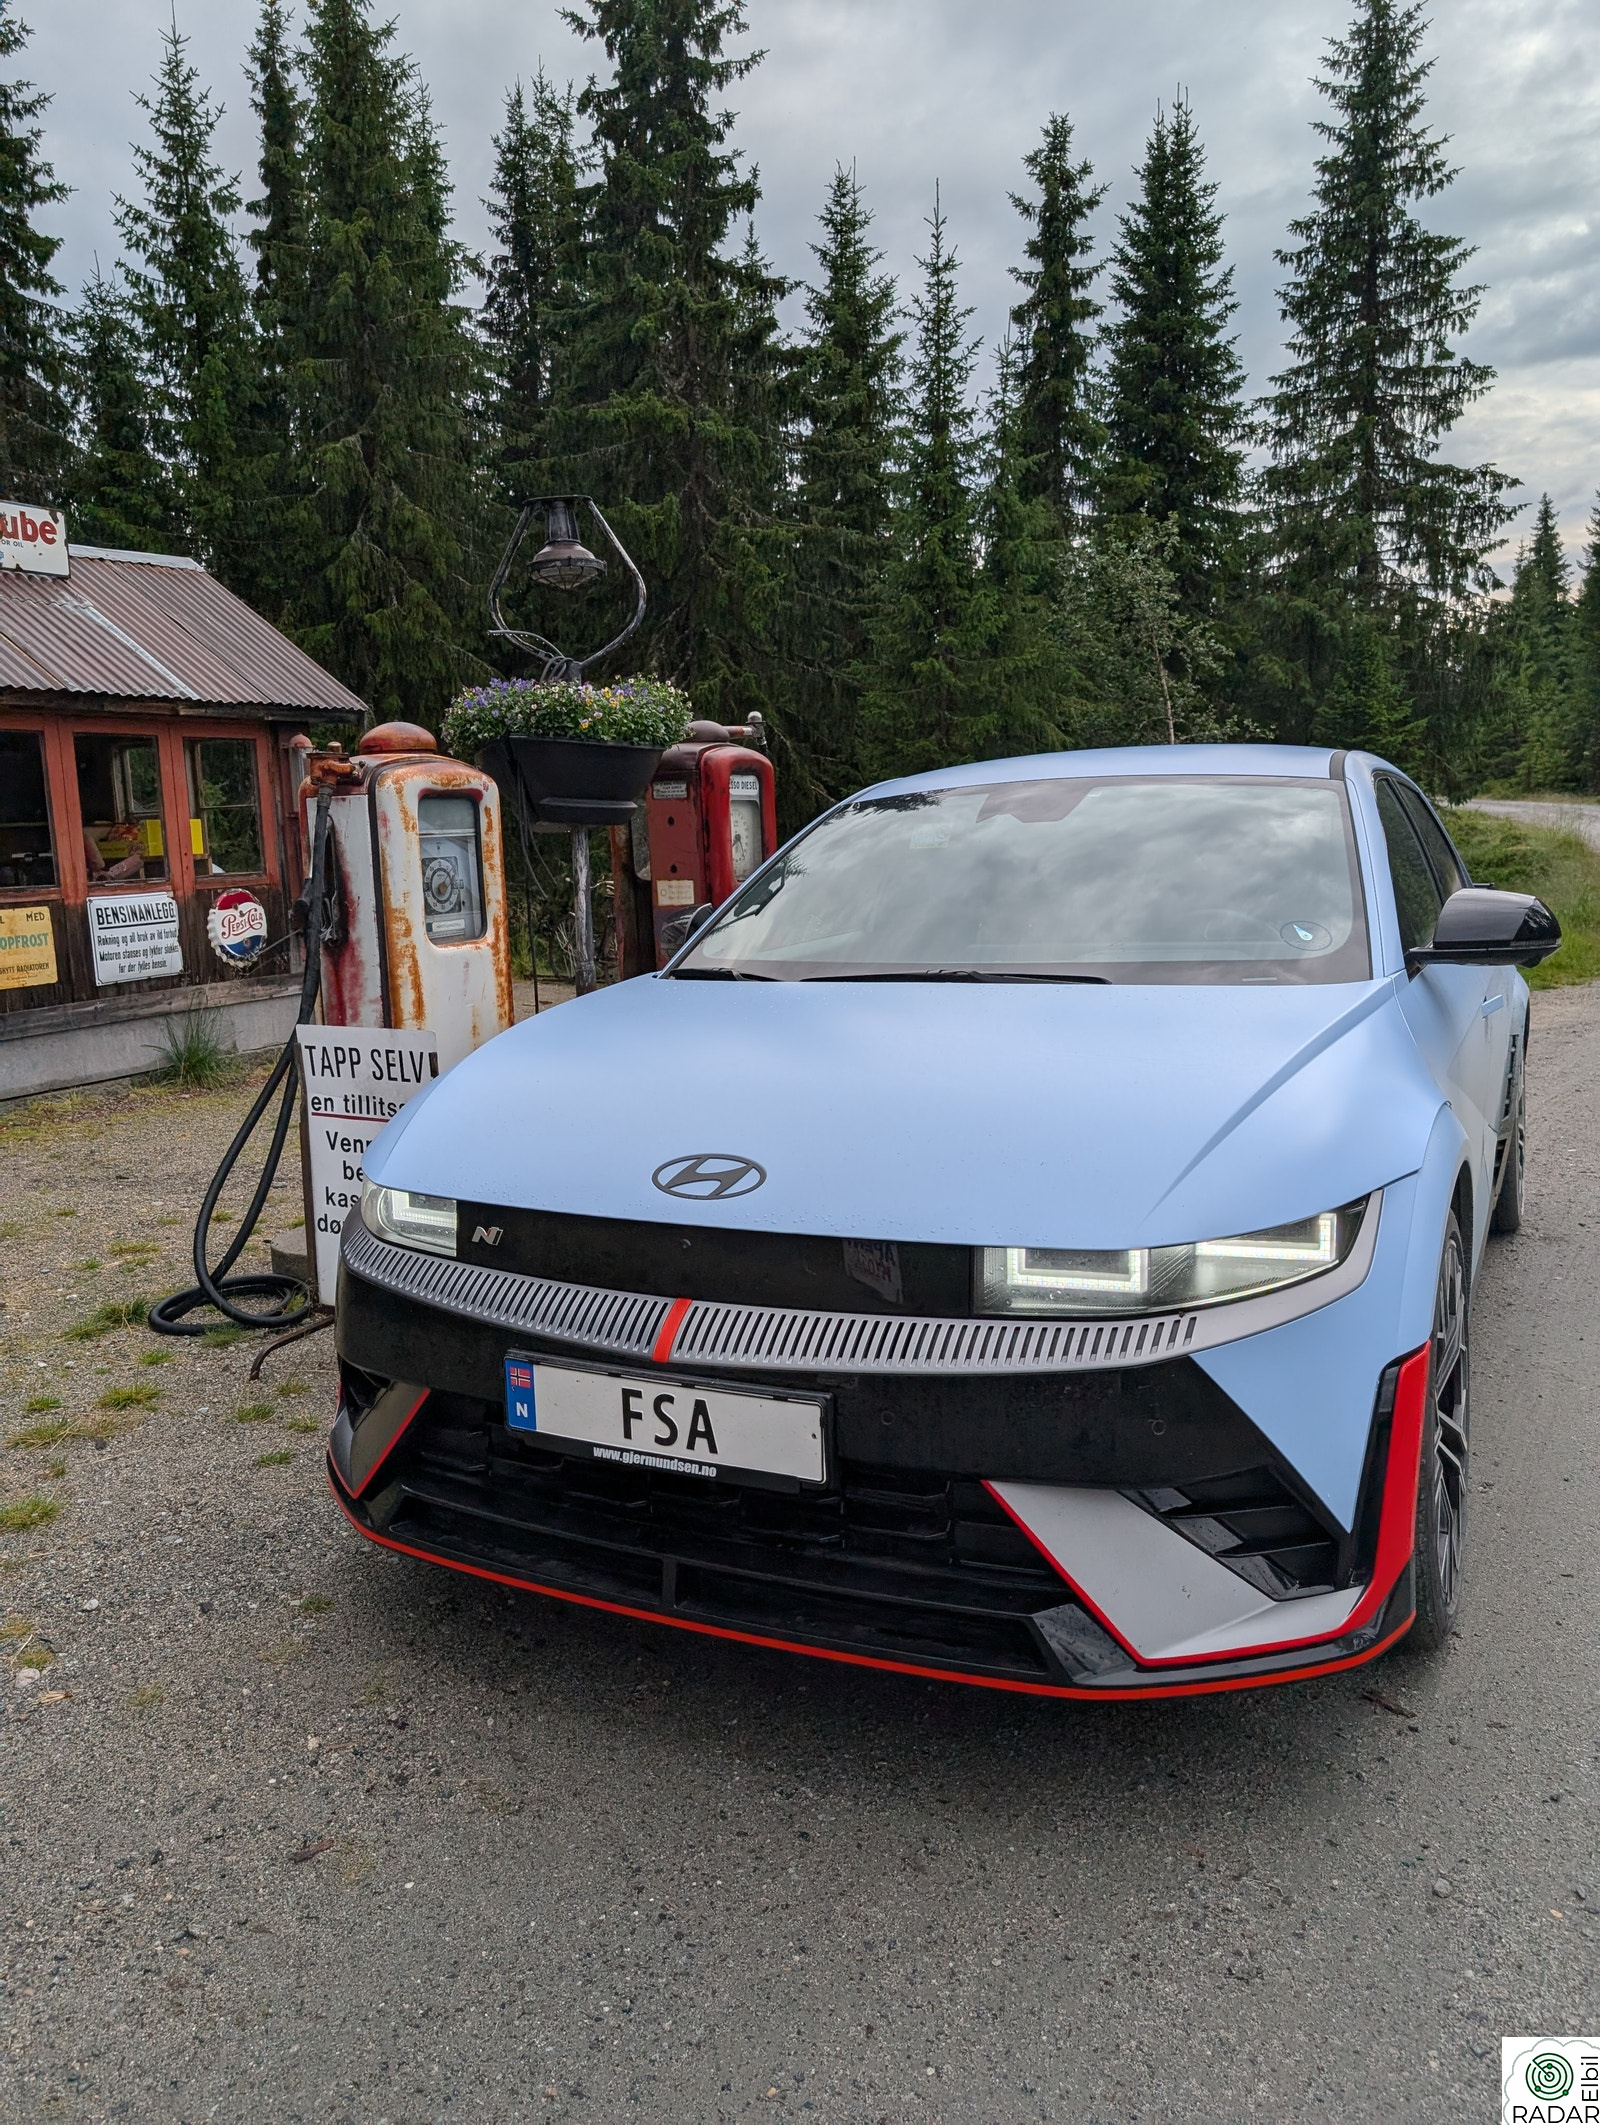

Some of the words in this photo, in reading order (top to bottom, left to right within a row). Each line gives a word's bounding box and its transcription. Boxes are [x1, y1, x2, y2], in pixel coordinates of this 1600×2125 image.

[26, 911, 45, 922] MED
[121, 935, 128, 946] og
[136, 930, 148, 942] bruk
[149, 931, 156, 940] av
[98, 951, 122, 961] Motoren
[122, 948, 142, 959] stanses
[142, 947, 149, 958] og
[127, 962, 137, 972] der
[304, 1045, 361, 1079] TAPP
[311, 1095, 335, 1112] en
[343, 1094, 405, 1118] tillits
[325, 1130, 372, 1154] Ven
[515, 1401, 528, 1418] N
[621, 1386, 719, 1455] FSA
[593, 1446, 718, 1478] www.gjermundsen.no
